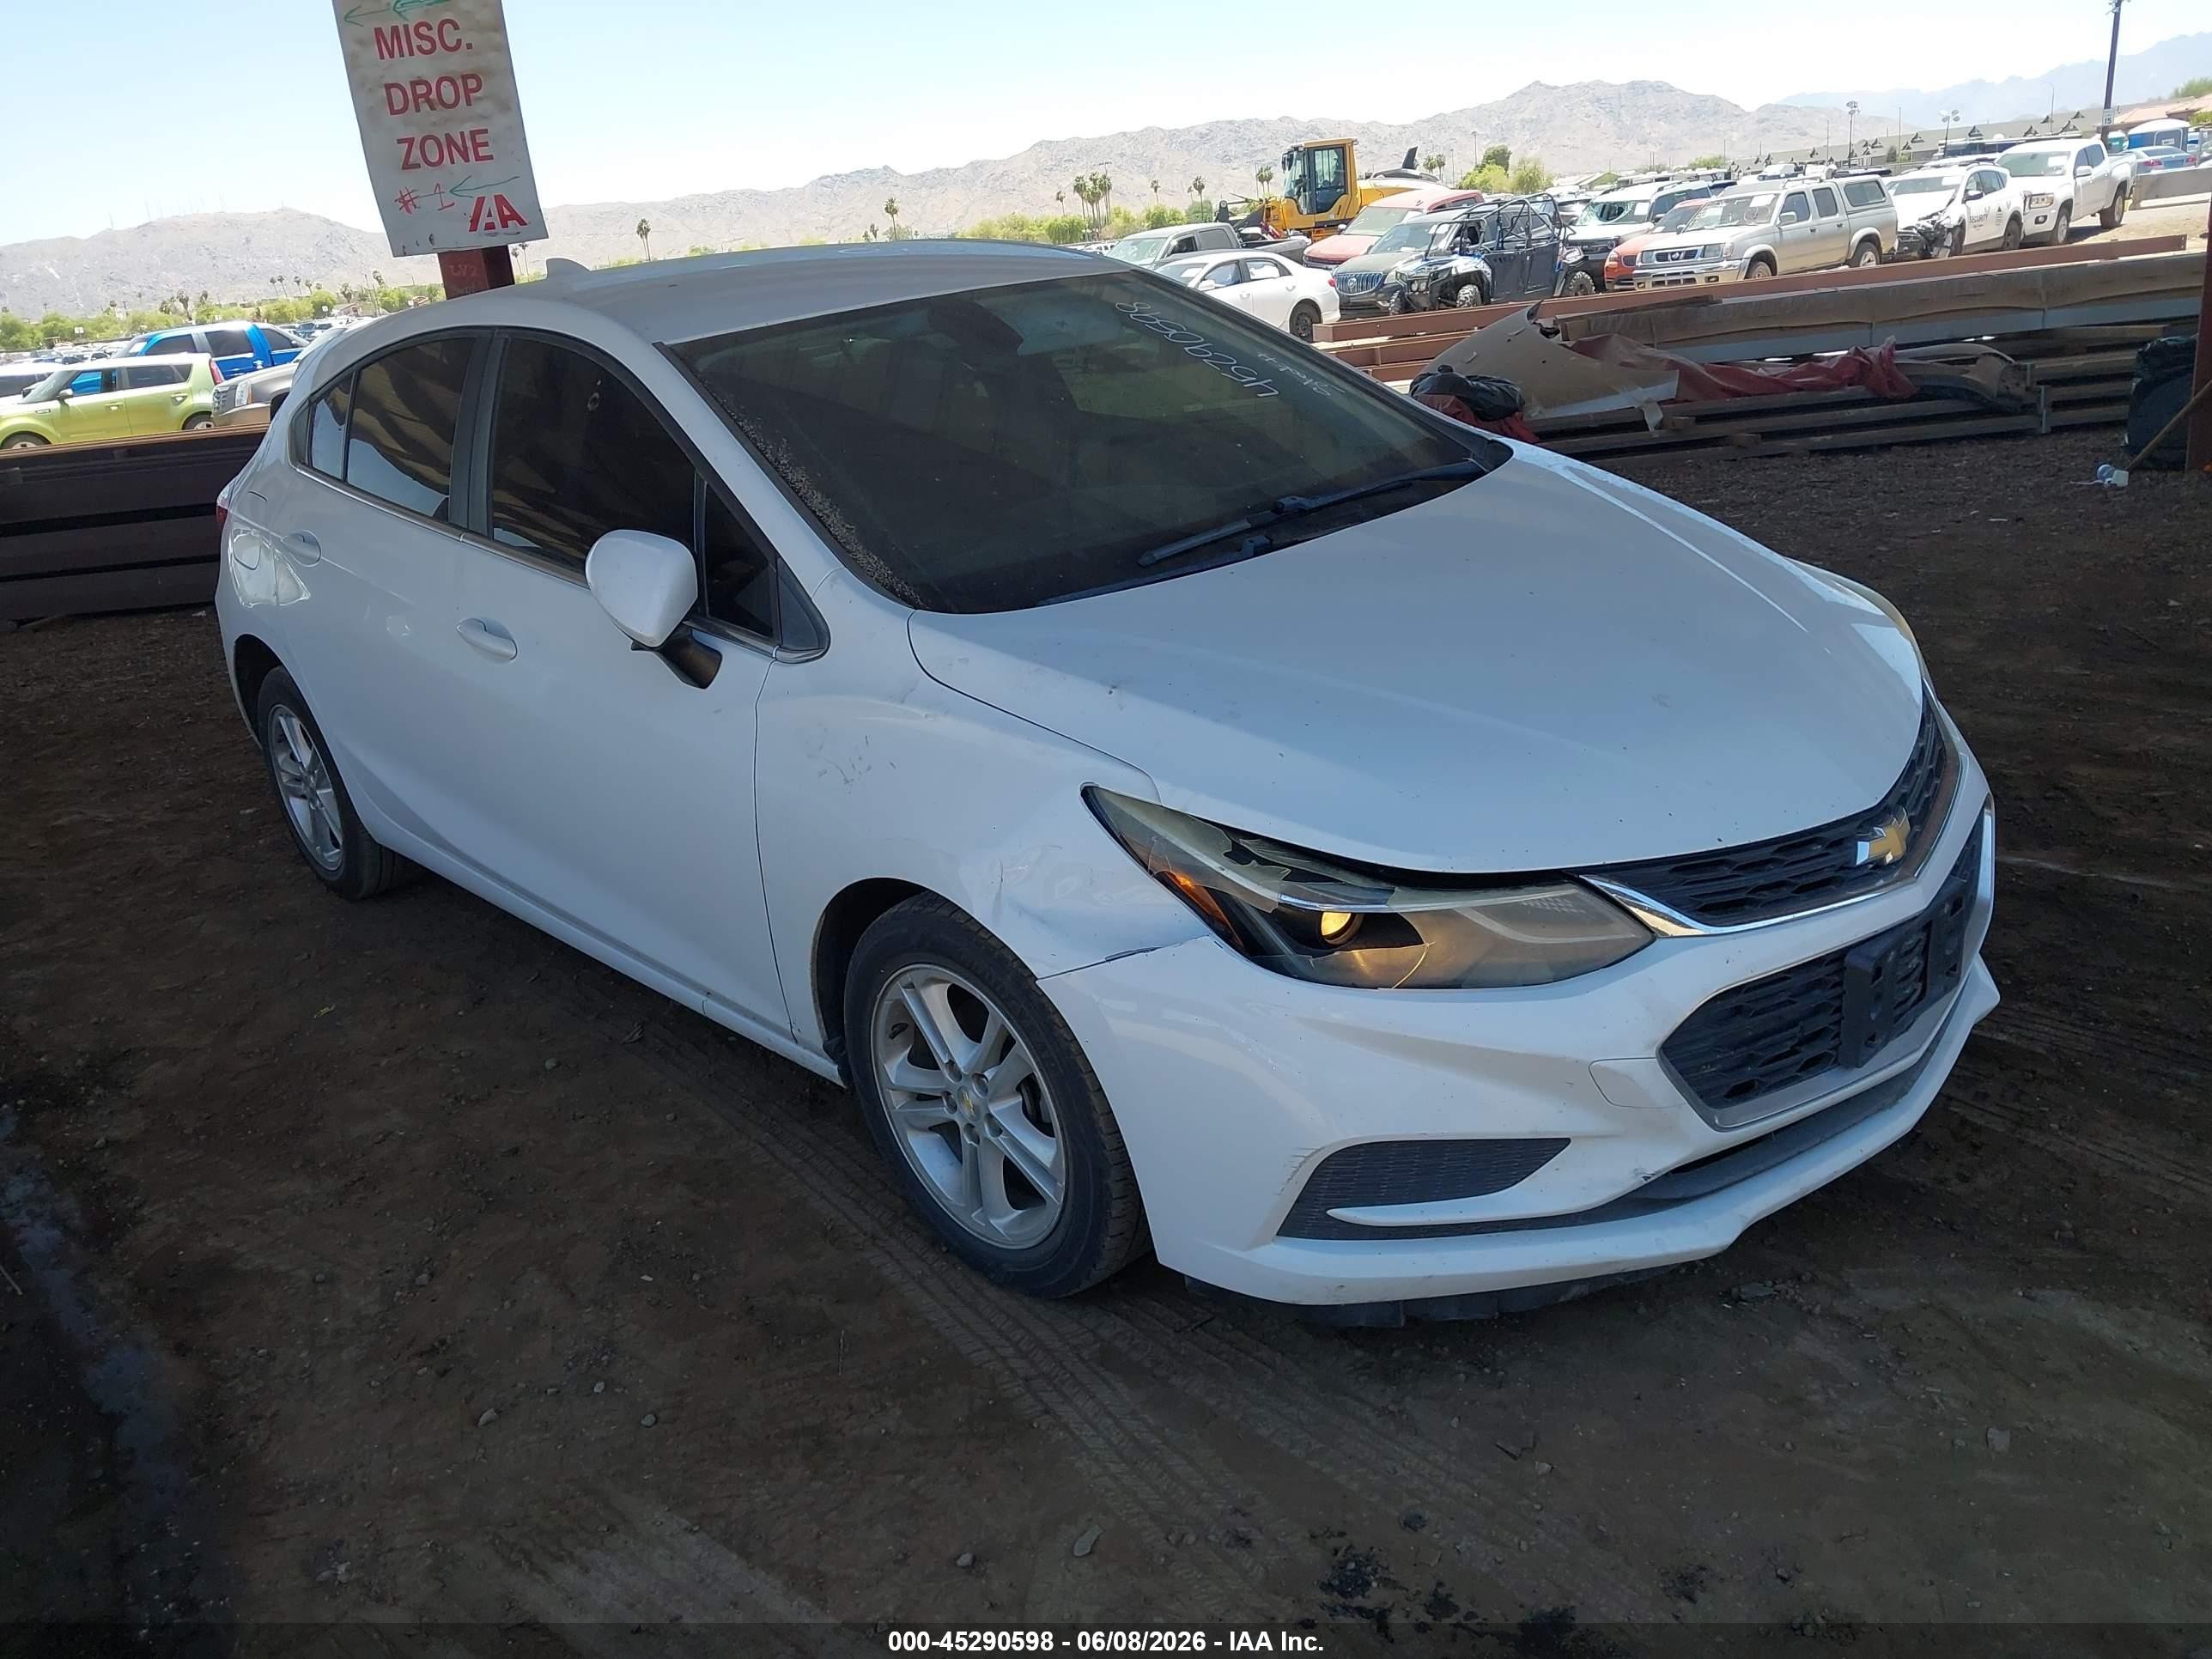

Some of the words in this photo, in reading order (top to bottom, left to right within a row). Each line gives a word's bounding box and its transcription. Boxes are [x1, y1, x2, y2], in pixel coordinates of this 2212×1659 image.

[374, 18, 473, 60] MISC.
[384, 73, 483, 115] DROP
[397, 129, 494, 170] ZONE
[1115, 302, 1279, 397] 45290598
